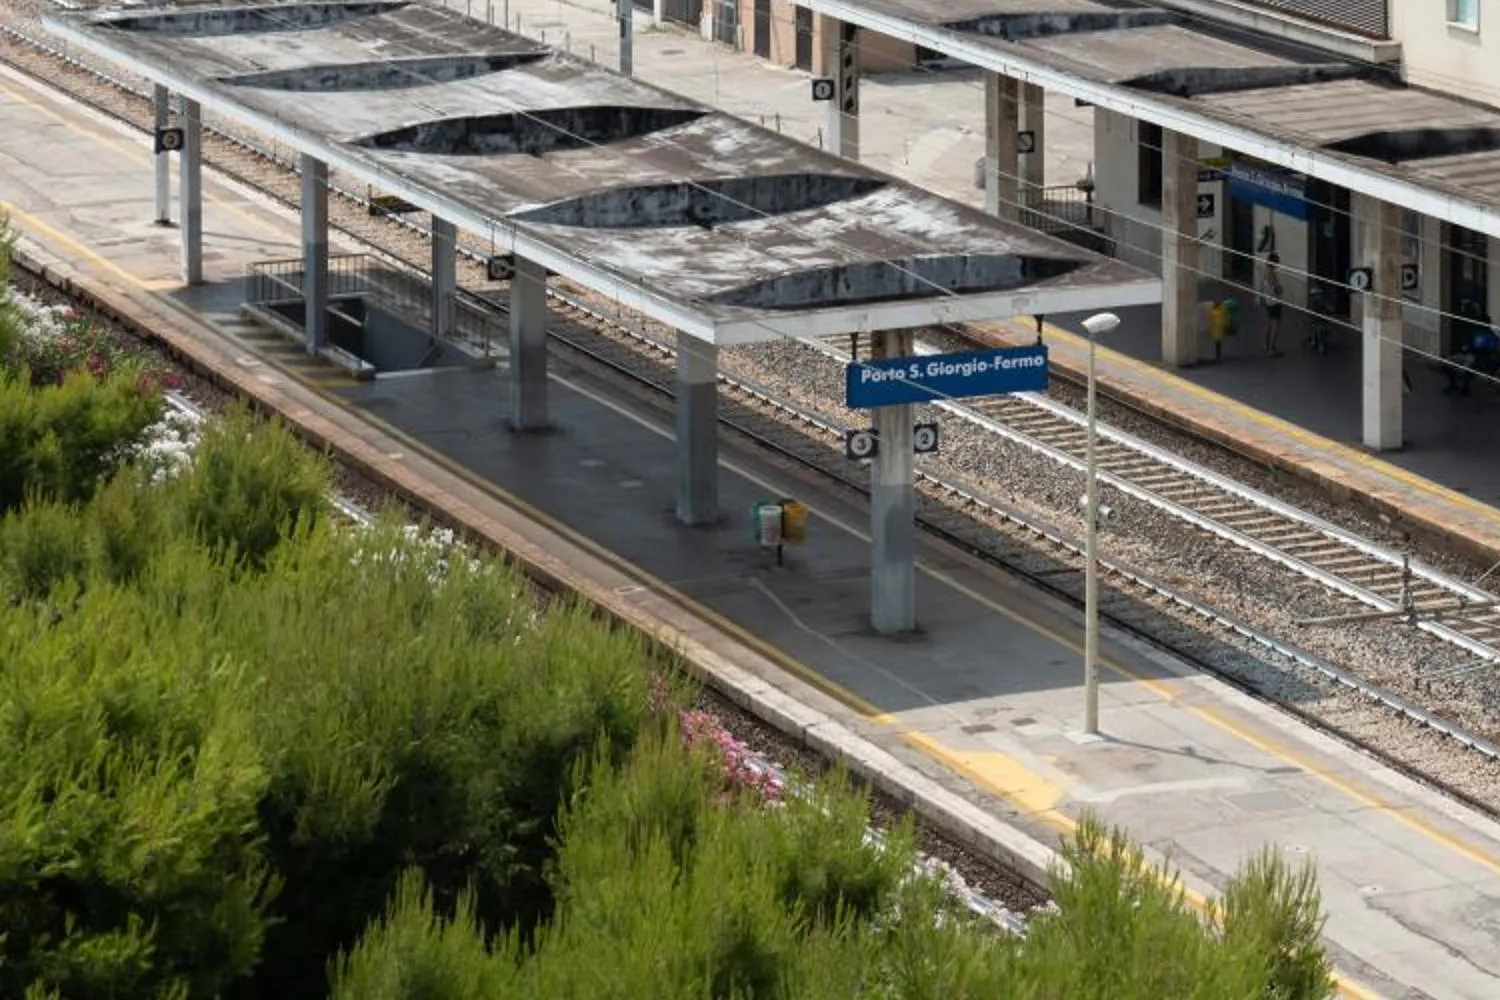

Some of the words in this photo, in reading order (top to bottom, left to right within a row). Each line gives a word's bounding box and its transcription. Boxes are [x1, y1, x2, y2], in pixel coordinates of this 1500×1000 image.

[861, 368, 905, 383] Porto
[909, 364, 923, 379] S.
[927, 354, 1044, 377] Giorgio-Fermo
